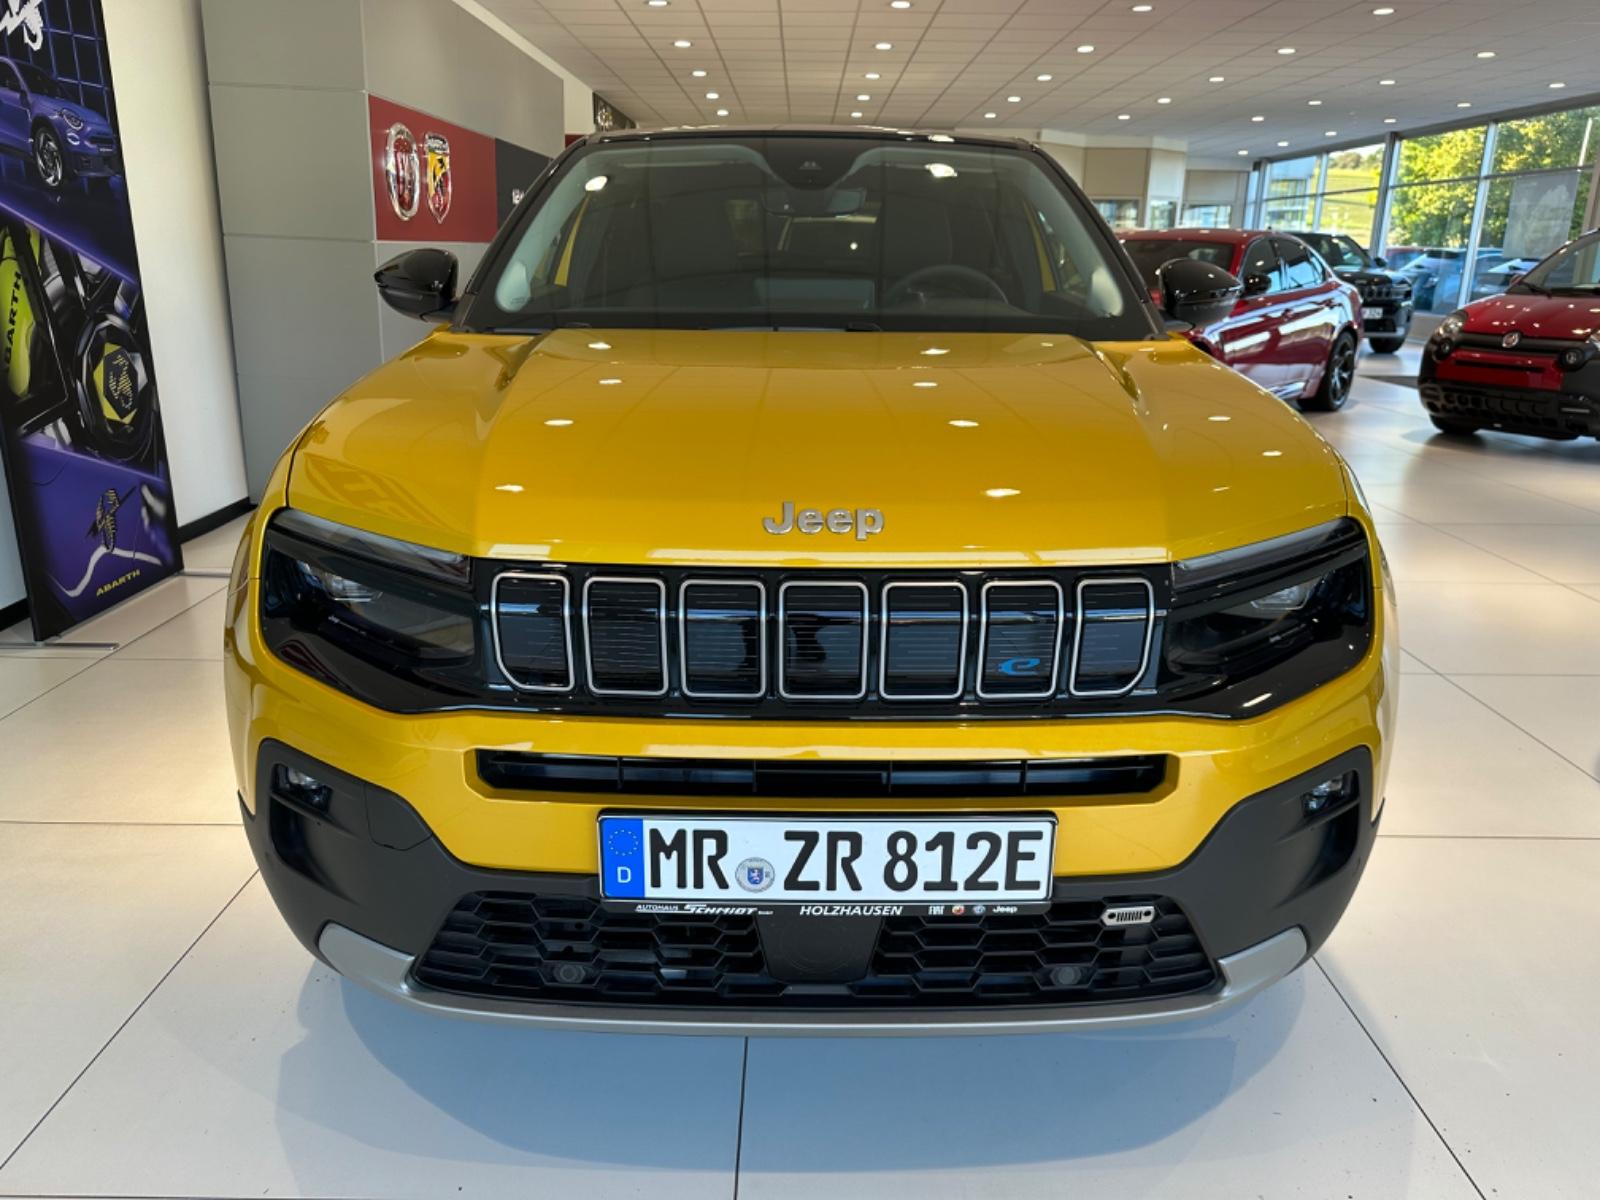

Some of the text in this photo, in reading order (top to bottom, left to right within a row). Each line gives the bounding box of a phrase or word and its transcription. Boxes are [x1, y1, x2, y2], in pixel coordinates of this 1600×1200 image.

[5, 271, 22, 368] BARTH
[763, 501, 884, 541] Jeep
[96, 569, 140, 597] ABARTH
[649, 828, 1043, 891] MR ZR 812E
[617, 866, 632, 884] D
[684, 904, 757, 915] SCHMIDT
[799, 906, 903, 916] HOLZHAUSEN
[992, 906, 1018, 914] Jeep
